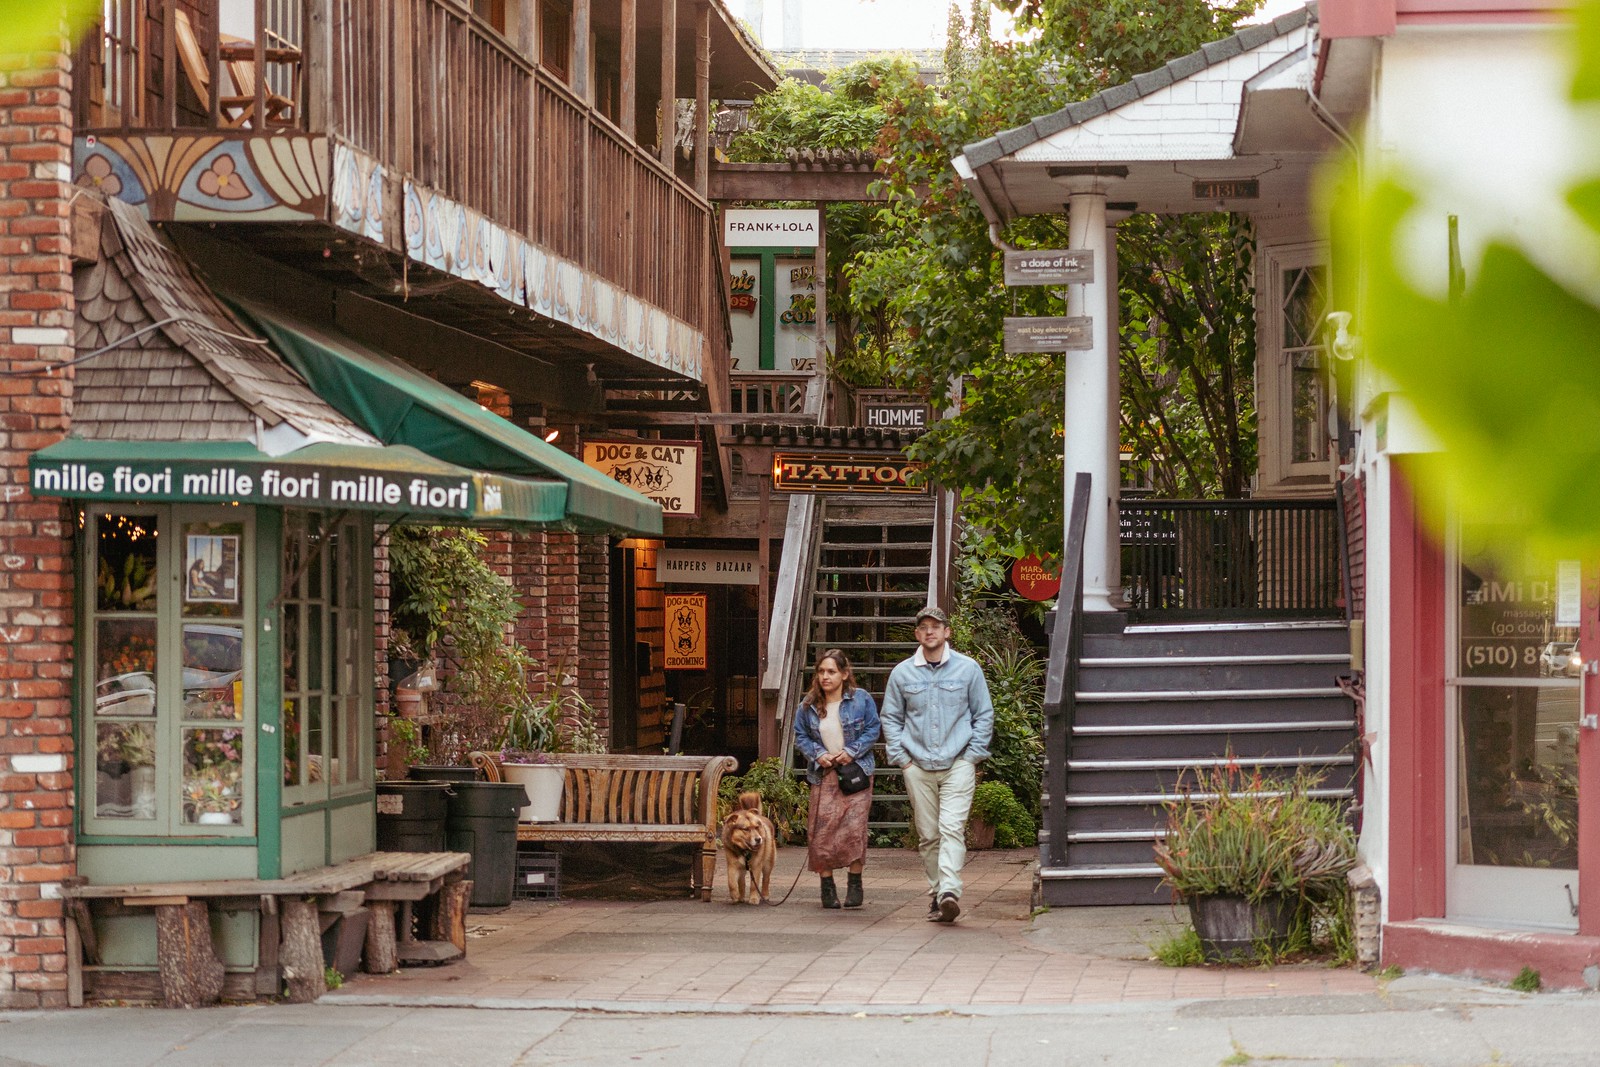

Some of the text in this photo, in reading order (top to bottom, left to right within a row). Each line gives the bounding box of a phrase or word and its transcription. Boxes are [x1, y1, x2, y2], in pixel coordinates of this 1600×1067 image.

[730, 222, 814, 232] FRANK+LOLA
[1029, 258, 1051, 267] dose
[1053, 257, 1063, 267] of
[1065, 257, 1078, 267] ink
[1032, 326, 1044, 334] bay
[868, 408, 925, 426] HOMME
[596, 444, 685, 465] DOG & CAT
[34, 463, 105, 493] mille
[113, 465, 172, 495] fiori
[183, 467, 254, 496] mille
[261, 469, 321, 499] fiori
[331, 474, 402, 504] mille
[409, 479, 469, 510] fiori
[666, 559, 753, 573] HARPERS BAZAAR
[666, 597, 682, 608] DOG
[689, 597, 704, 608] CAT
[1491, 620, 1515, 637] (go
[666, 656, 704, 666] GROOMING
[1466, 645, 1518, 669] (510)
